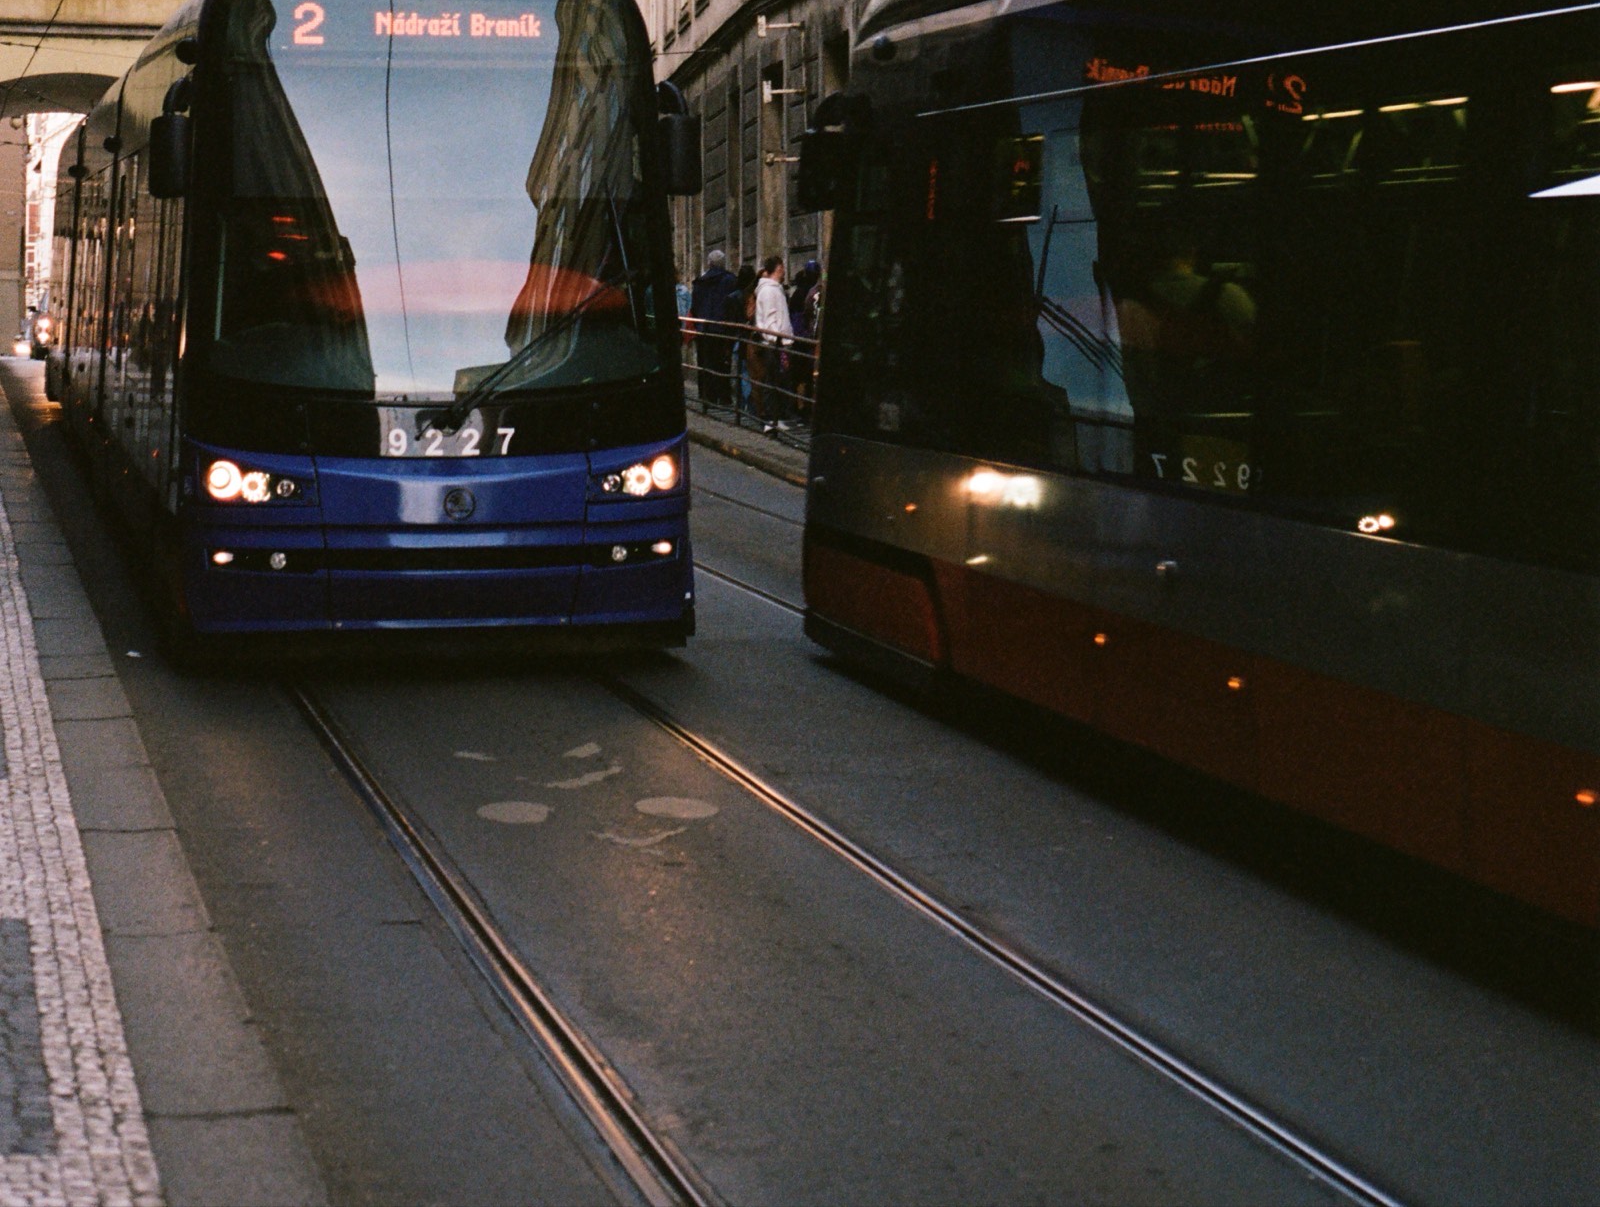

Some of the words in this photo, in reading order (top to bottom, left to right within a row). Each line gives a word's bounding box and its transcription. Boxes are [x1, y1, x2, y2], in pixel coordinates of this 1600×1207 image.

[294, 2, 325, 45] 2
[374, 11, 461, 37] Nádraží
[470, 13, 541, 38] Braník
[388, 427, 516, 456] 9227
